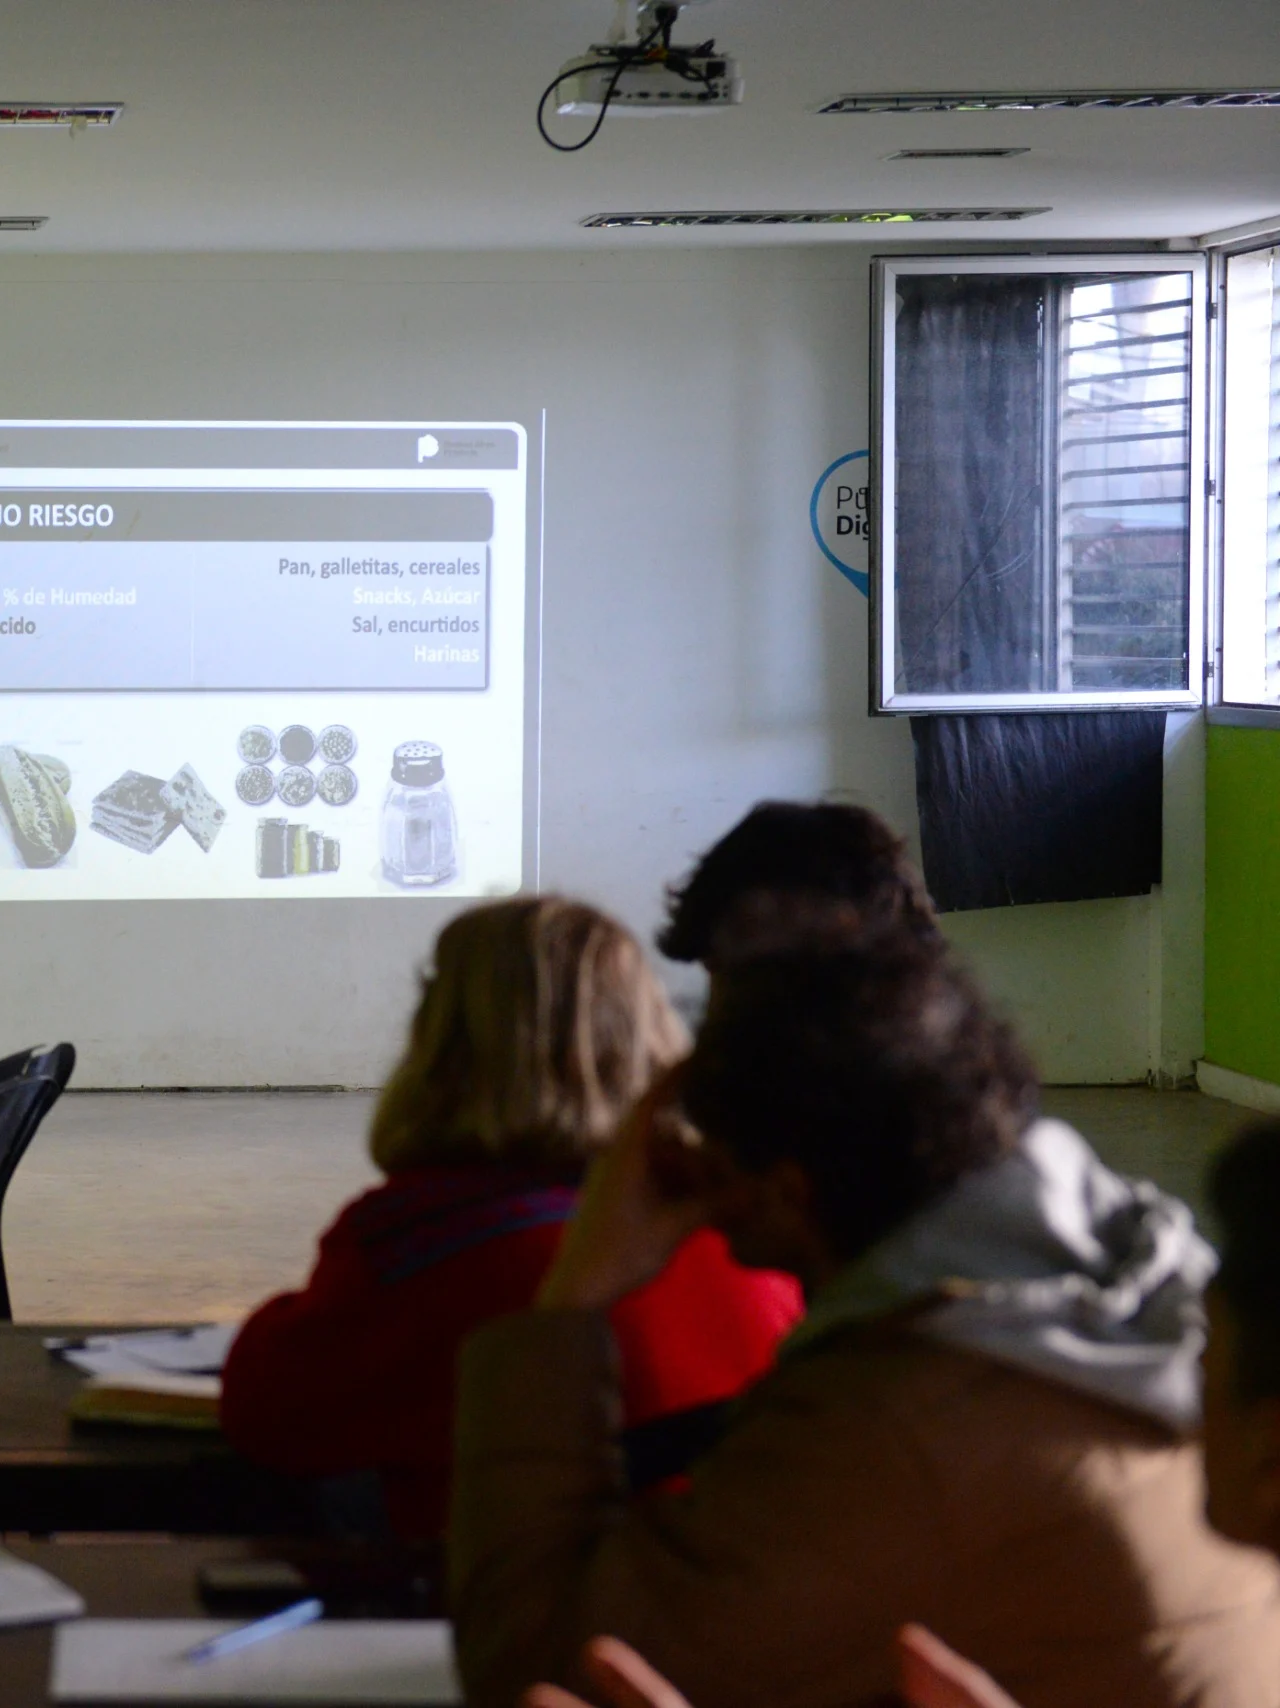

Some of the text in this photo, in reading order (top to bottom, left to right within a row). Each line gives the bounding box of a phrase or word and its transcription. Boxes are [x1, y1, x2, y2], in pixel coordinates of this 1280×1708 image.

[29, 504, 114, 527] RIESGO
[278, 557, 480, 579] Pan, galletitas, cereales
[3, 588, 19, 605] %
[23, 587, 45, 606] de
[51, 586, 137, 606] Humedad
[353, 585, 481, 606] Snacks, Azúcar
[352, 615, 480, 635] Sal, encurtidos
[414, 645, 480, 663] Harinas
